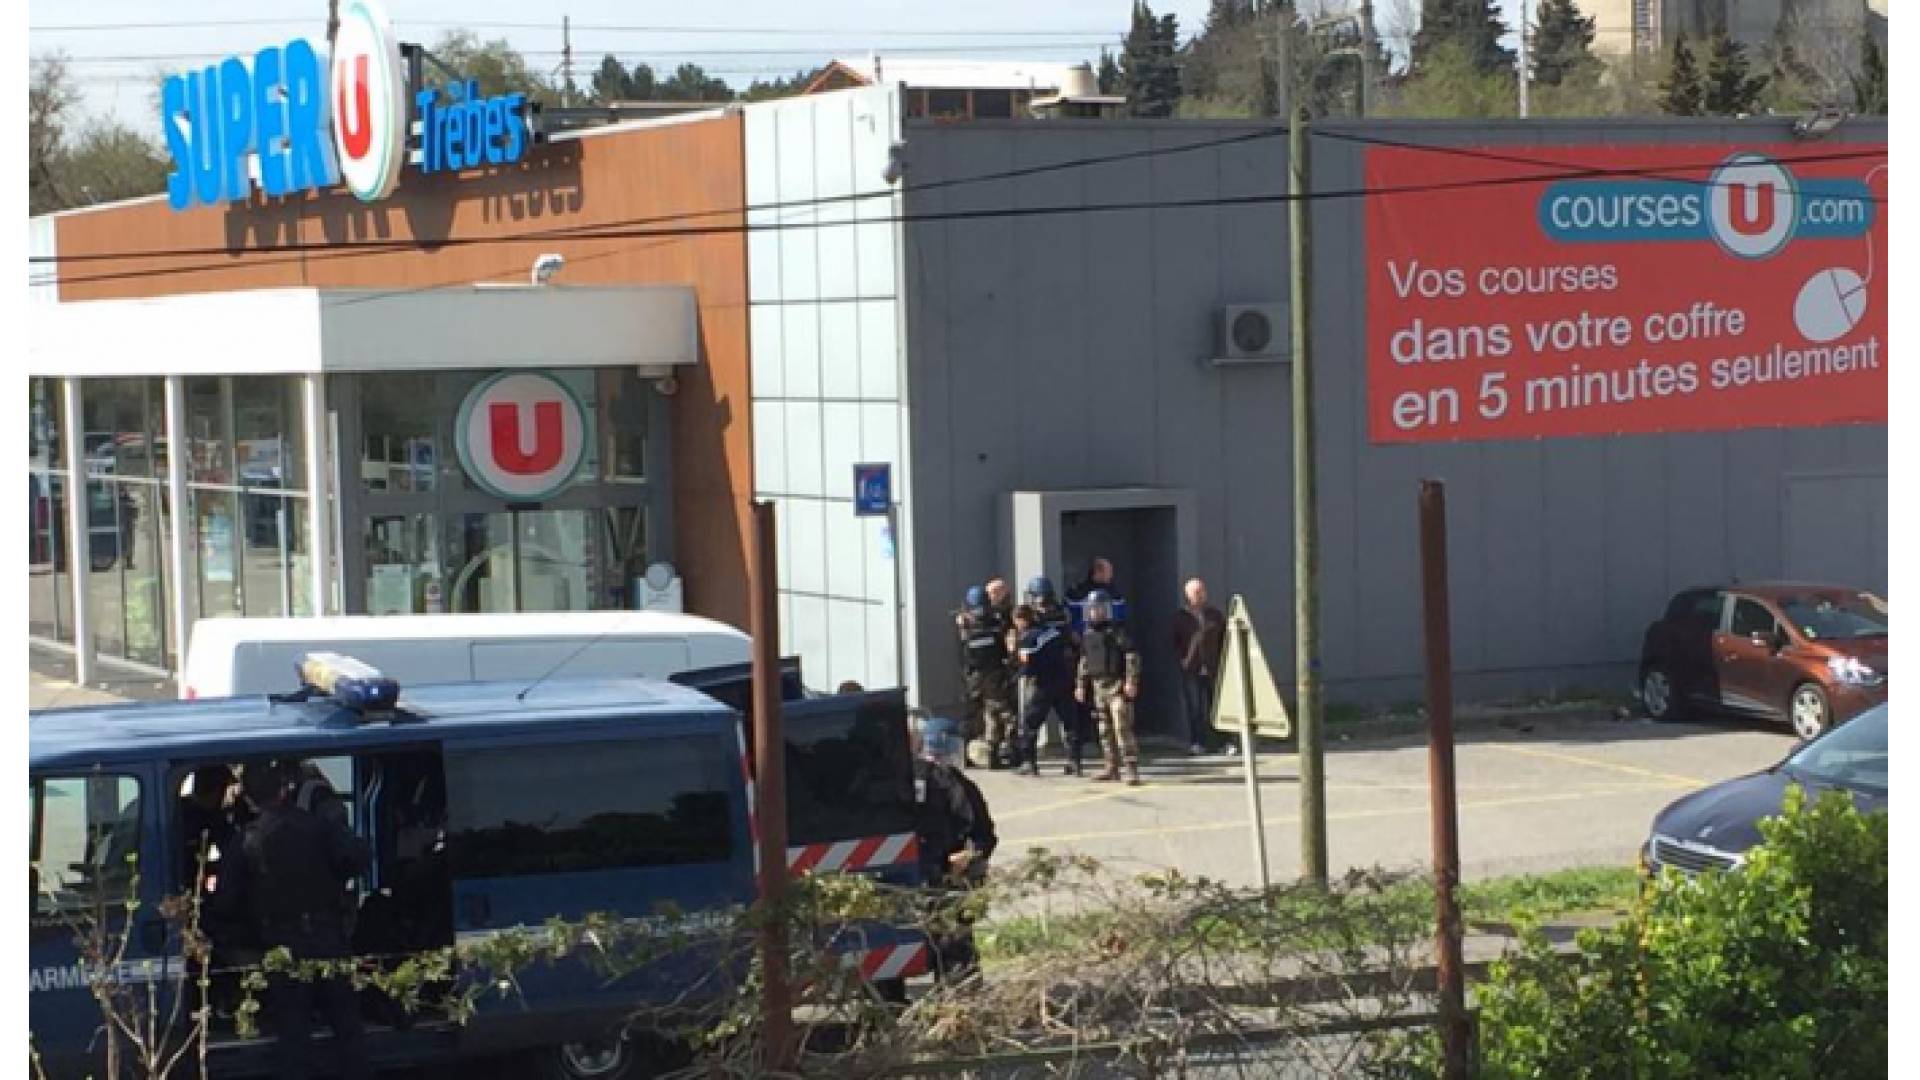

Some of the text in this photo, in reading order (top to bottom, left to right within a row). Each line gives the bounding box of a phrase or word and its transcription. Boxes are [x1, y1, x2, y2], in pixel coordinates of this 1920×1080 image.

[163, 38, 525, 211] SUPER U Trèbes
[1551, 183, 1865, 235] courses U .com
[1388, 259, 1617, 298] Vos courses
[1390, 302, 1745, 364] dans votre coffre
[1392, 336, 1879, 429] en 5 minutes seulement
[489, 401, 562, 475] U
